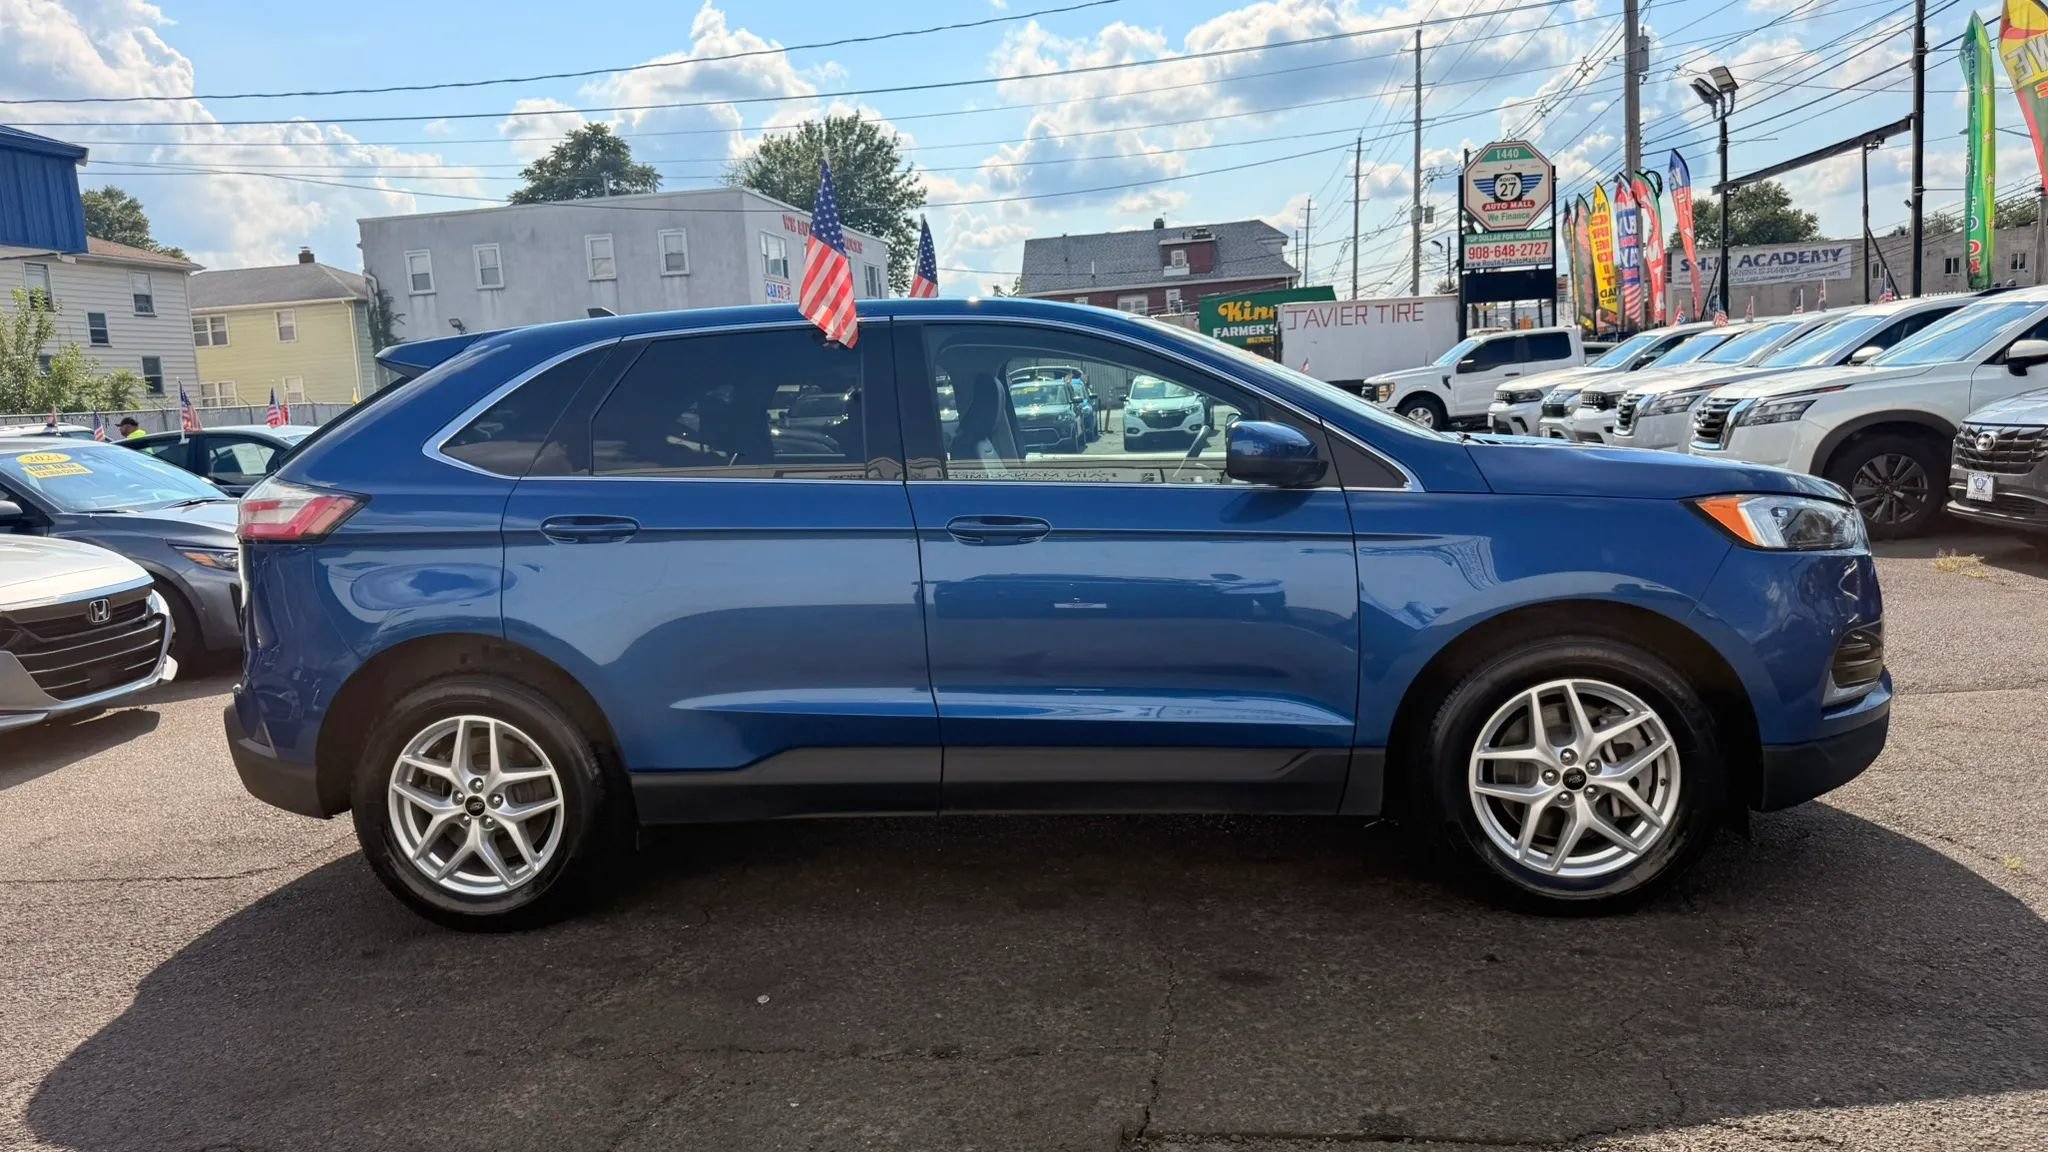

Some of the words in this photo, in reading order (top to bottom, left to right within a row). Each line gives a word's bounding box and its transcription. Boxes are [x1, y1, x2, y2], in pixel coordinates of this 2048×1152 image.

[1496, 148, 1520, 160] 1440
[1500, 182, 1517, 197] 27
[1484, 202, 1508, 211] AUTO
[1510, 200, 1533, 209] MALL
[1487, 213, 1500, 222] We
[1501, 211, 1531, 221] Finance
[1465, 235, 1479, 243] TOP
[1480, 232, 1503, 241] DOLLAR
[1503, 232, 1515, 240] FOR
[1515, 231, 1532, 239] YOUR
[1468, 241, 1549, 260] 908-648-2727
[1737, 247, 1843, 268] ACADEMY
[1217, 300, 1275, 322] Kin
[1375, 302, 1425, 324] TIRE
